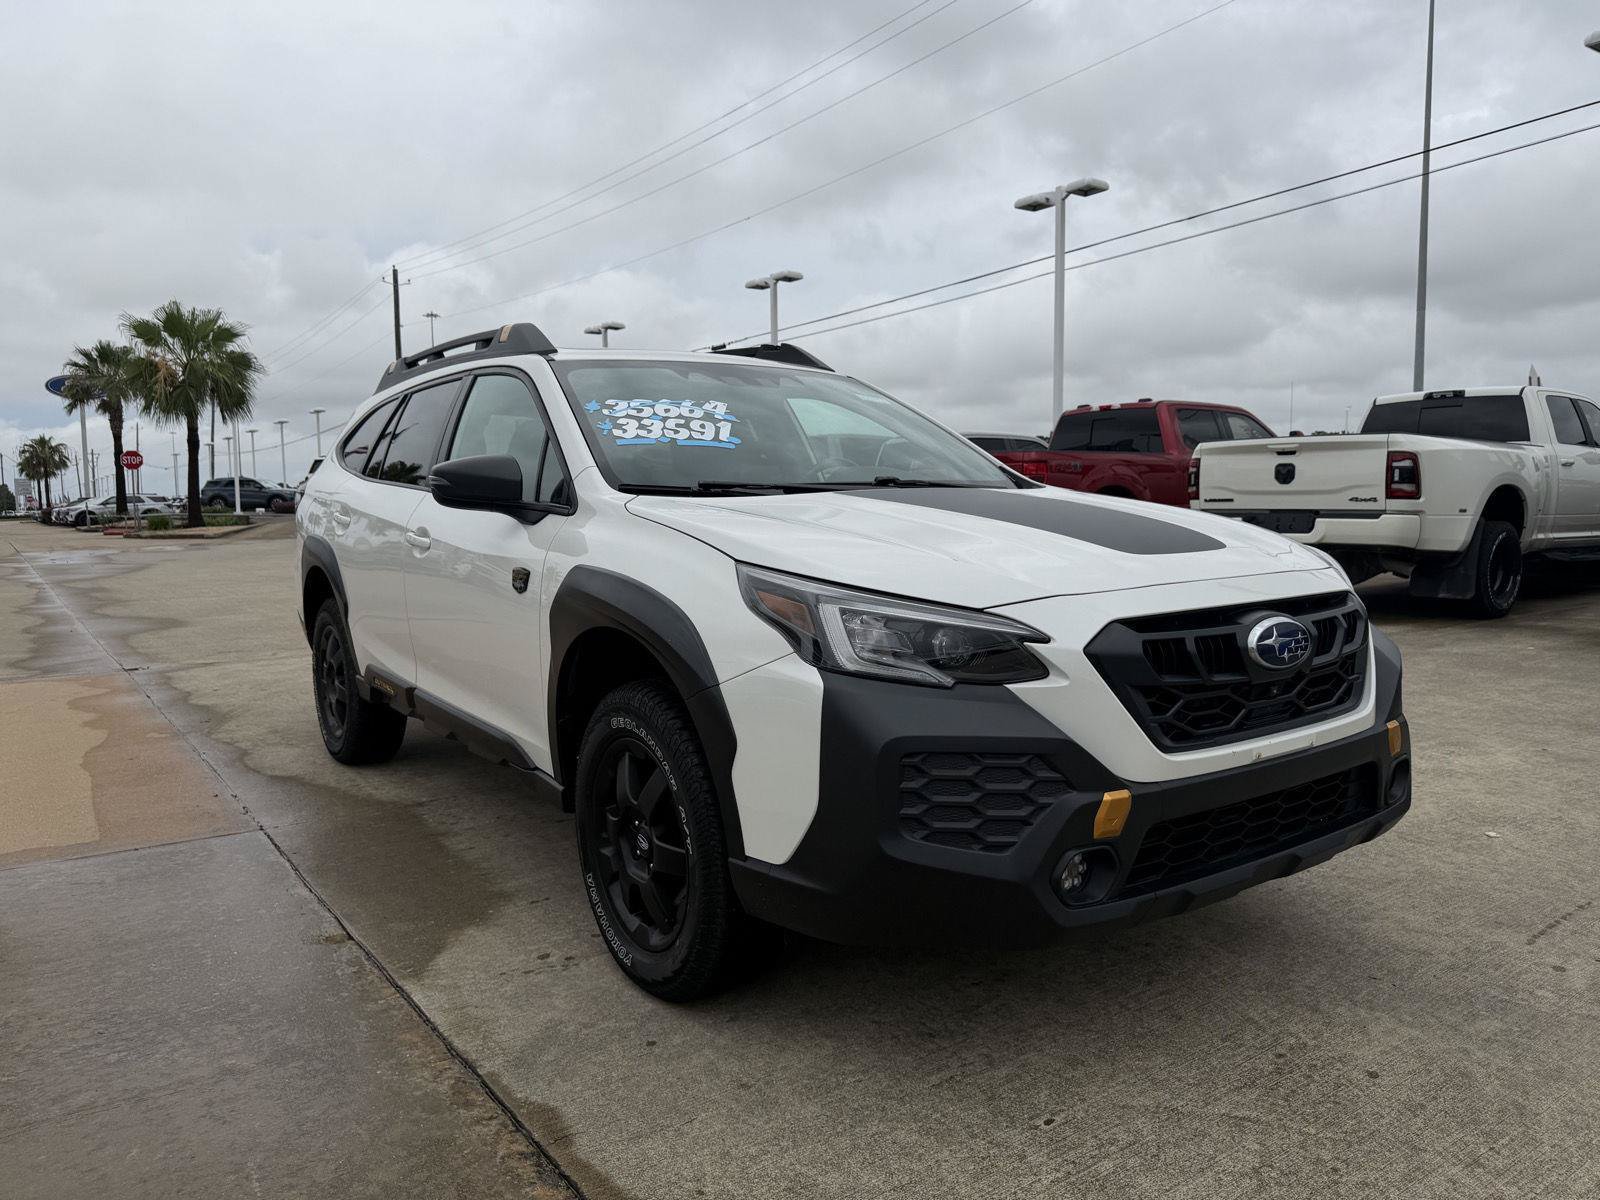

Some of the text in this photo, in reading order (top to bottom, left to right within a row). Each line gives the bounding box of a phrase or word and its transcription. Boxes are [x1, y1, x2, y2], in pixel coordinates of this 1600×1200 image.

[122, 456, 141, 464] STOP
[611, 717, 678, 791] GEOLANDAR
[586, 873, 633, 966] YOKOHAMA
